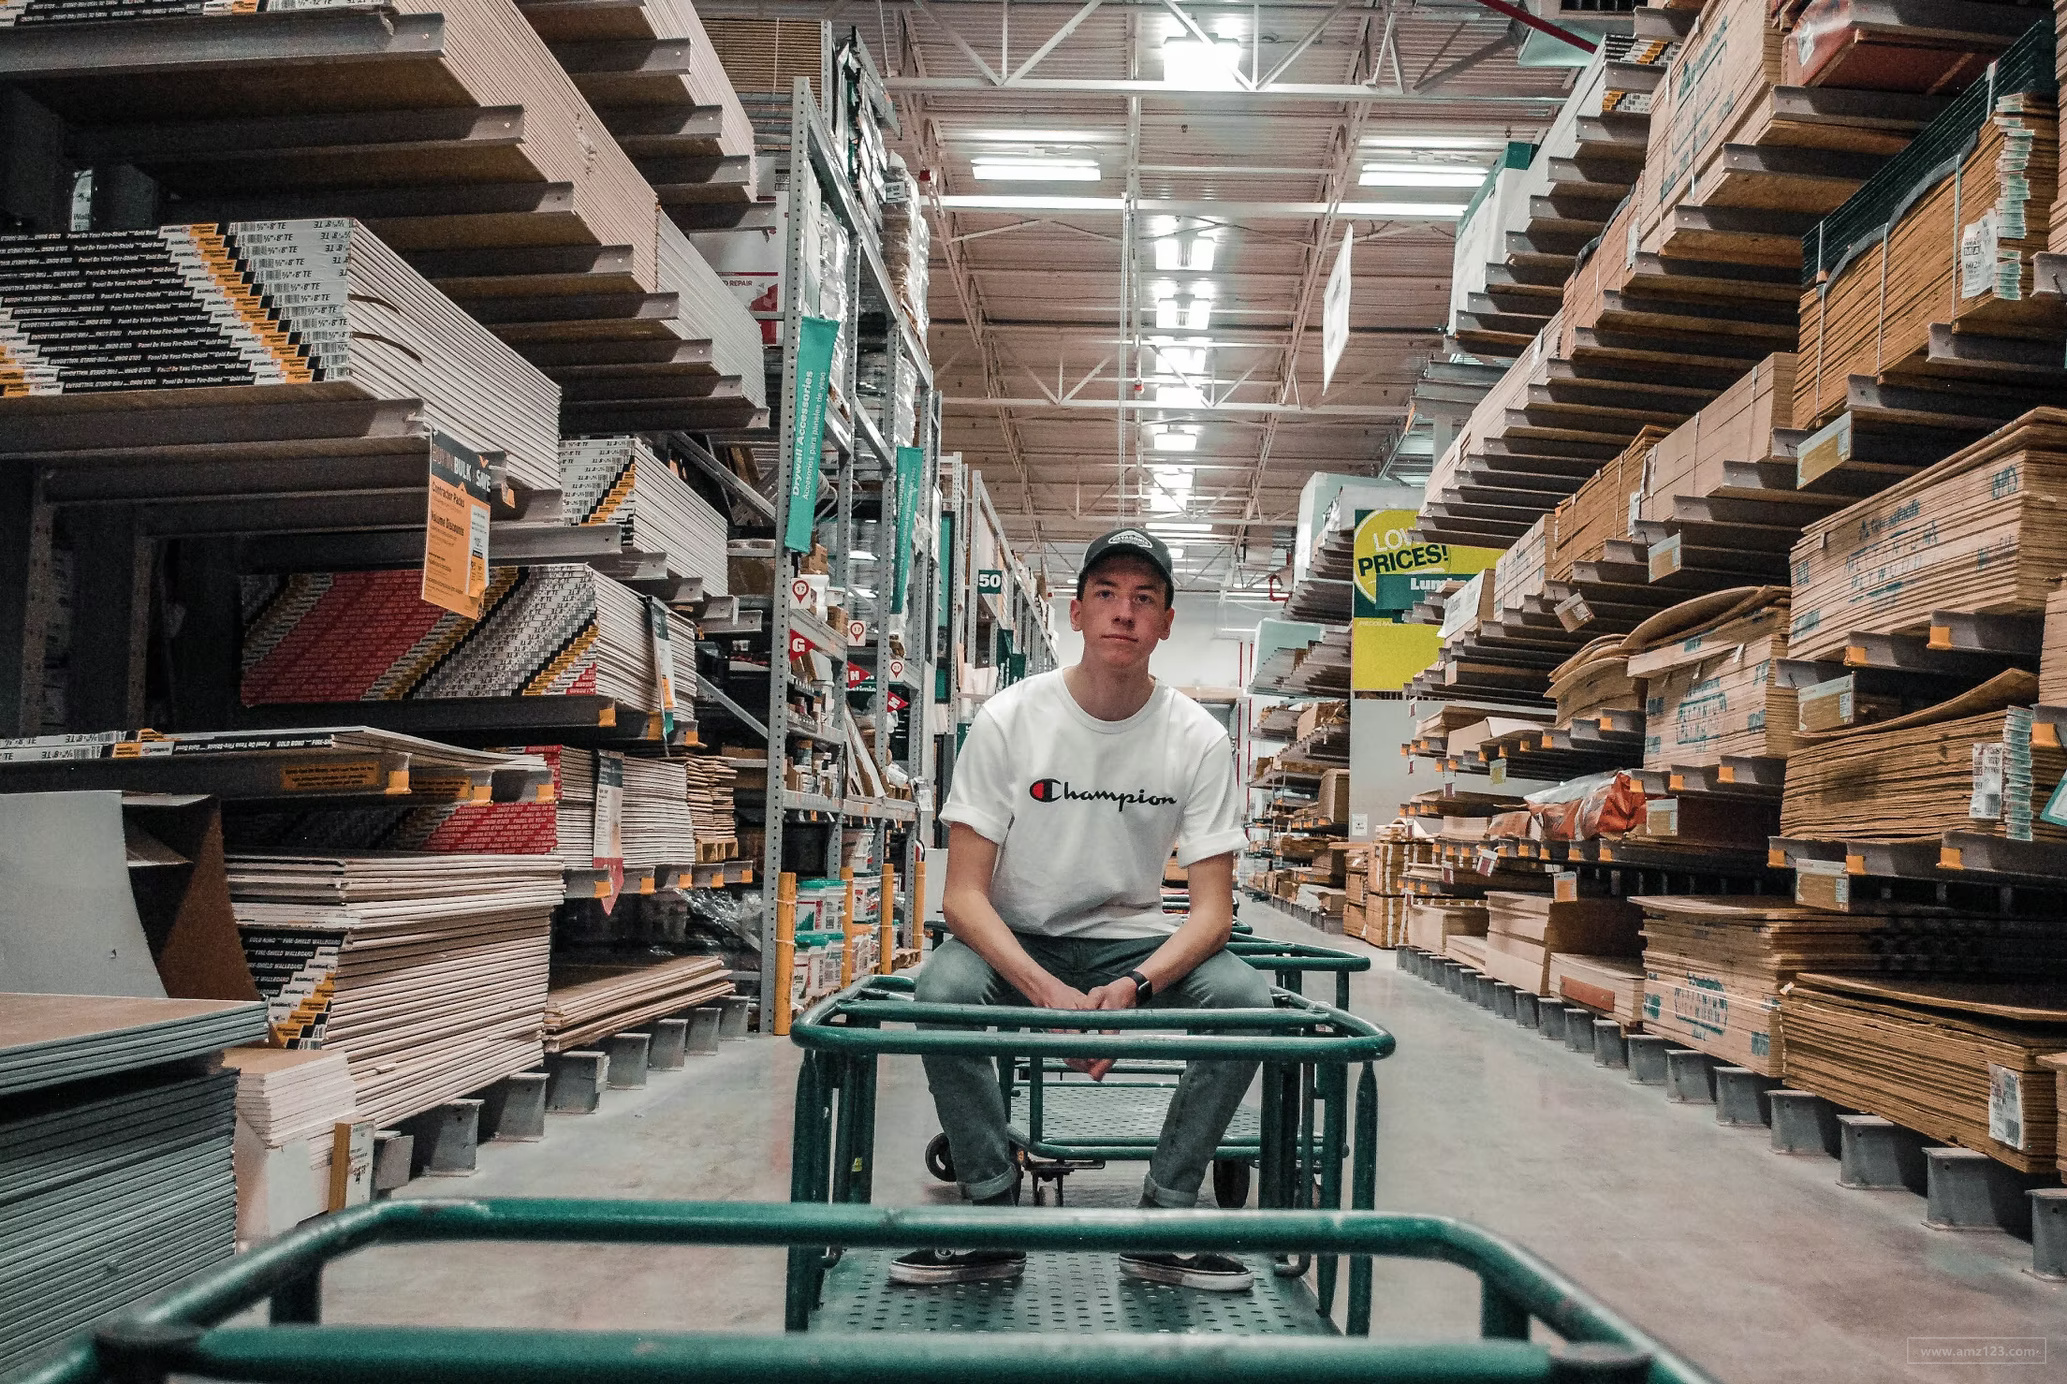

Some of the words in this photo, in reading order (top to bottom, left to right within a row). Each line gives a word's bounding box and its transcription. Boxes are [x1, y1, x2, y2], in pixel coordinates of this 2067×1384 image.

[797, 371, 813, 445] Accessories
[816, 393, 822, 402] de
[813, 405, 821, 435] paneles
[454, 456, 472, 482] BULK
[476, 469, 491, 493] SAVE
[793, 449, 802, 496] Drywall
[1358, 544, 1449, 577] PRICES!
[979, 574, 1001, 588] 50
[792, 638, 805, 653] G
[850, 670, 860, 681] H
[1029, 778, 1177, 812] Champion
